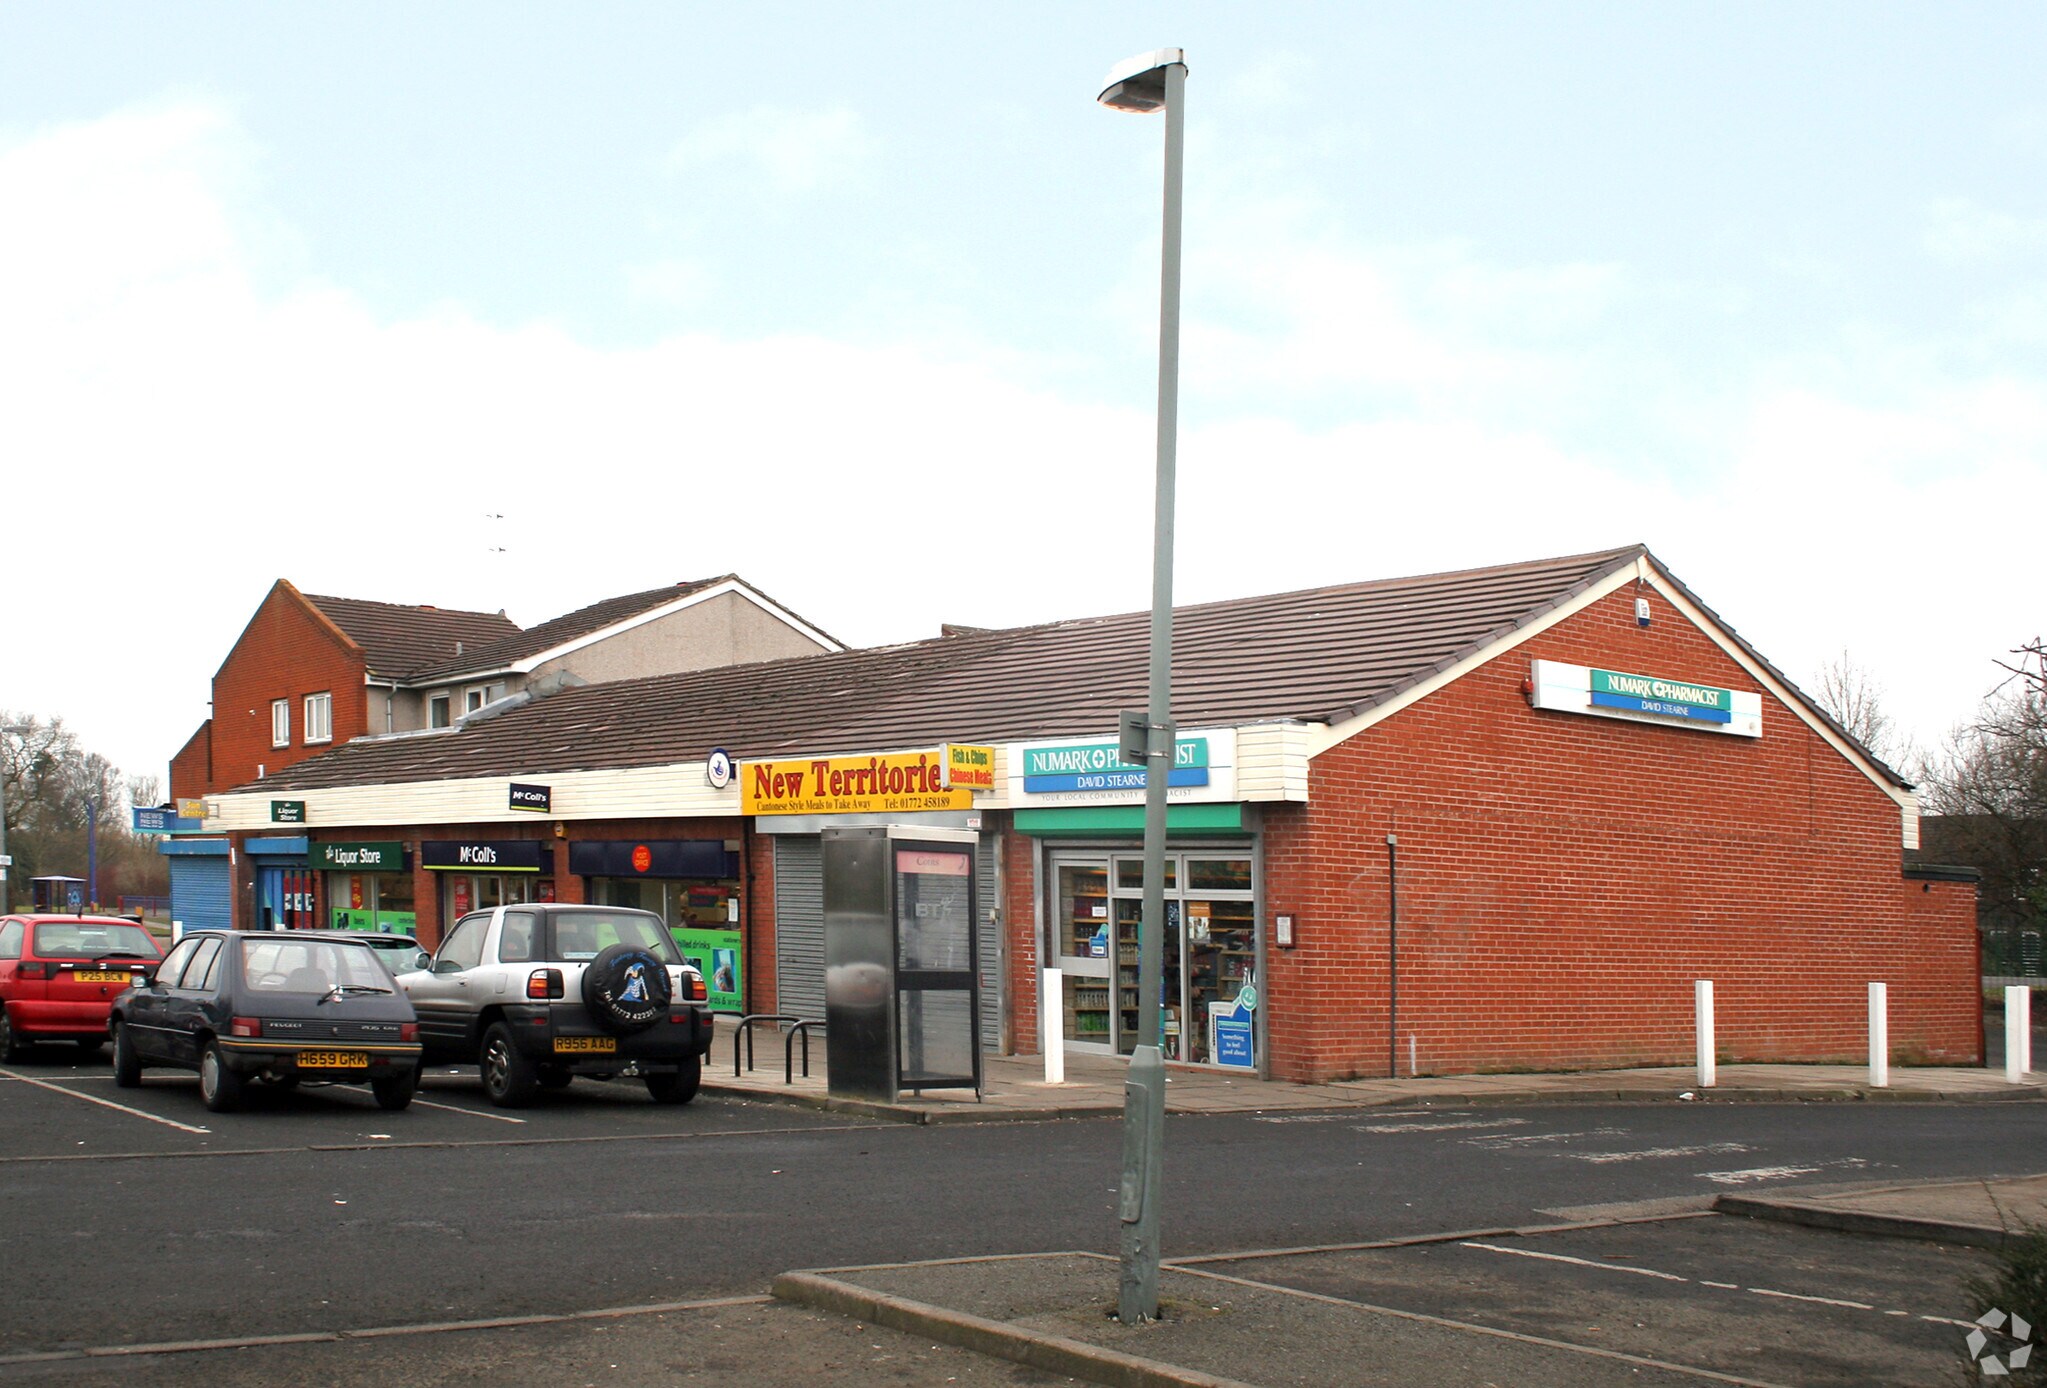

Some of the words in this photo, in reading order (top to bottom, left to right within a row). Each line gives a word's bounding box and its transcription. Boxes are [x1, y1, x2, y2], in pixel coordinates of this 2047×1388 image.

[1608, 675, 1652, 698] NUMARK
[1660, 681, 1719, 706] PHARMACIST
[1641, 700, 1661, 712] DAVID
[1662, 705, 1688, 716] STEARNE
[953, 749, 964, 763] Fish
[971, 750, 987, 766] Chips
[1032, 750, 1092, 773] NUMARK
[754, 764, 804, 799] New
[950, 768, 973, 783] Chinese
[975, 769, 992, 784] Meals
[1077, 775, 1105, 788] DAVID
[1107, 774, 1146, 787] STEARNE
[1089, 791, 1138, 800] COMMUNITY
[757, 801, 787, 811] Cantonese
[789, 800, 804, 813] Style
[806, 800, 825, 810] Meals
[826, 801, 832, 809] to
[834, 799, 850, 809] Take
[852, 799, 871, 811] Away
[884, 798, 898, 809] Tel:
[900, 797, 921, 809] 01772
[924, 797, 950, 808] 458189
[335, 848, 358, 867] Liquor
[360, 848, 380, 864] Store
[460, 846, 496, 863] McColl's
[916, 855, 939, 866] Coins
[915, 903, 940, 917] BT
[81, 972, 101, 981] P25
[611, 1003, 631, 1019] 01772
[556, 1038, 588, 1049] R956
[591, 1038, 614, 1049] AAG
[299, 1053, 336, 1065] H659
[339, 1054, 367, 1066] GRK
